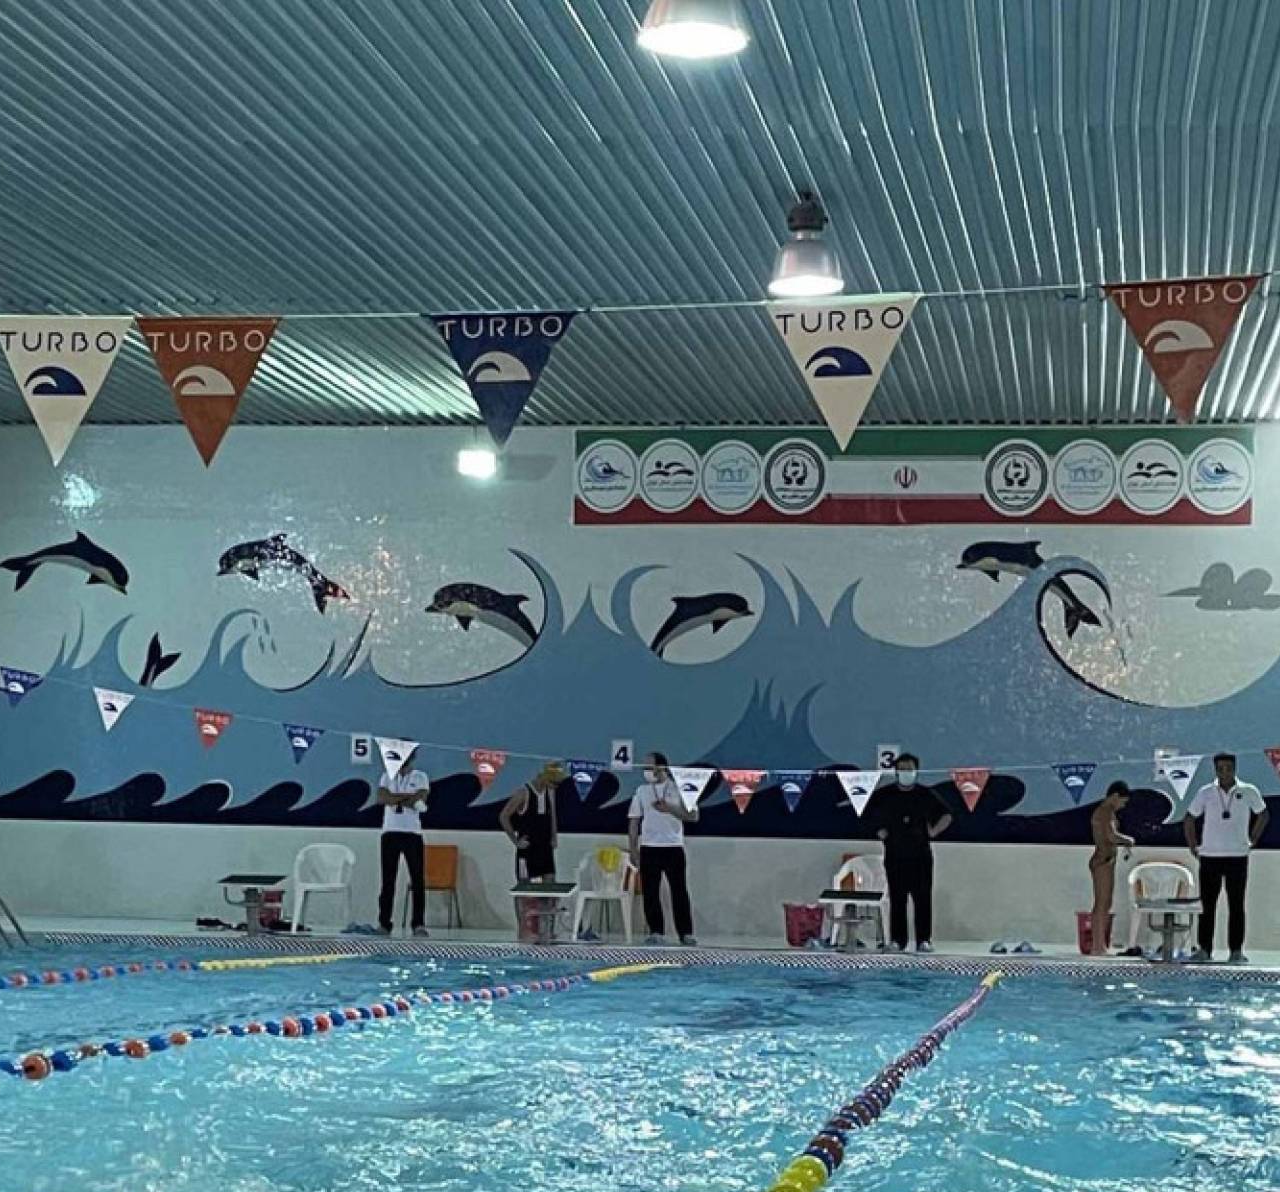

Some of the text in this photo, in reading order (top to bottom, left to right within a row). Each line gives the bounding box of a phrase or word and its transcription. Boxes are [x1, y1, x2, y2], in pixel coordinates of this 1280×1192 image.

[1113, 282, 1248, 308] TURBO
[438, 316, 562, 339] TURBO
[776, 306, 904, 335] TURBO
[0, 331, 116, 353] TURBO
[146, 331, 266, 353] TURBO
[354, 739, 367, 756] 5
[614, 747, 630, 763] 4
[880, 751, 896, 768] 3
